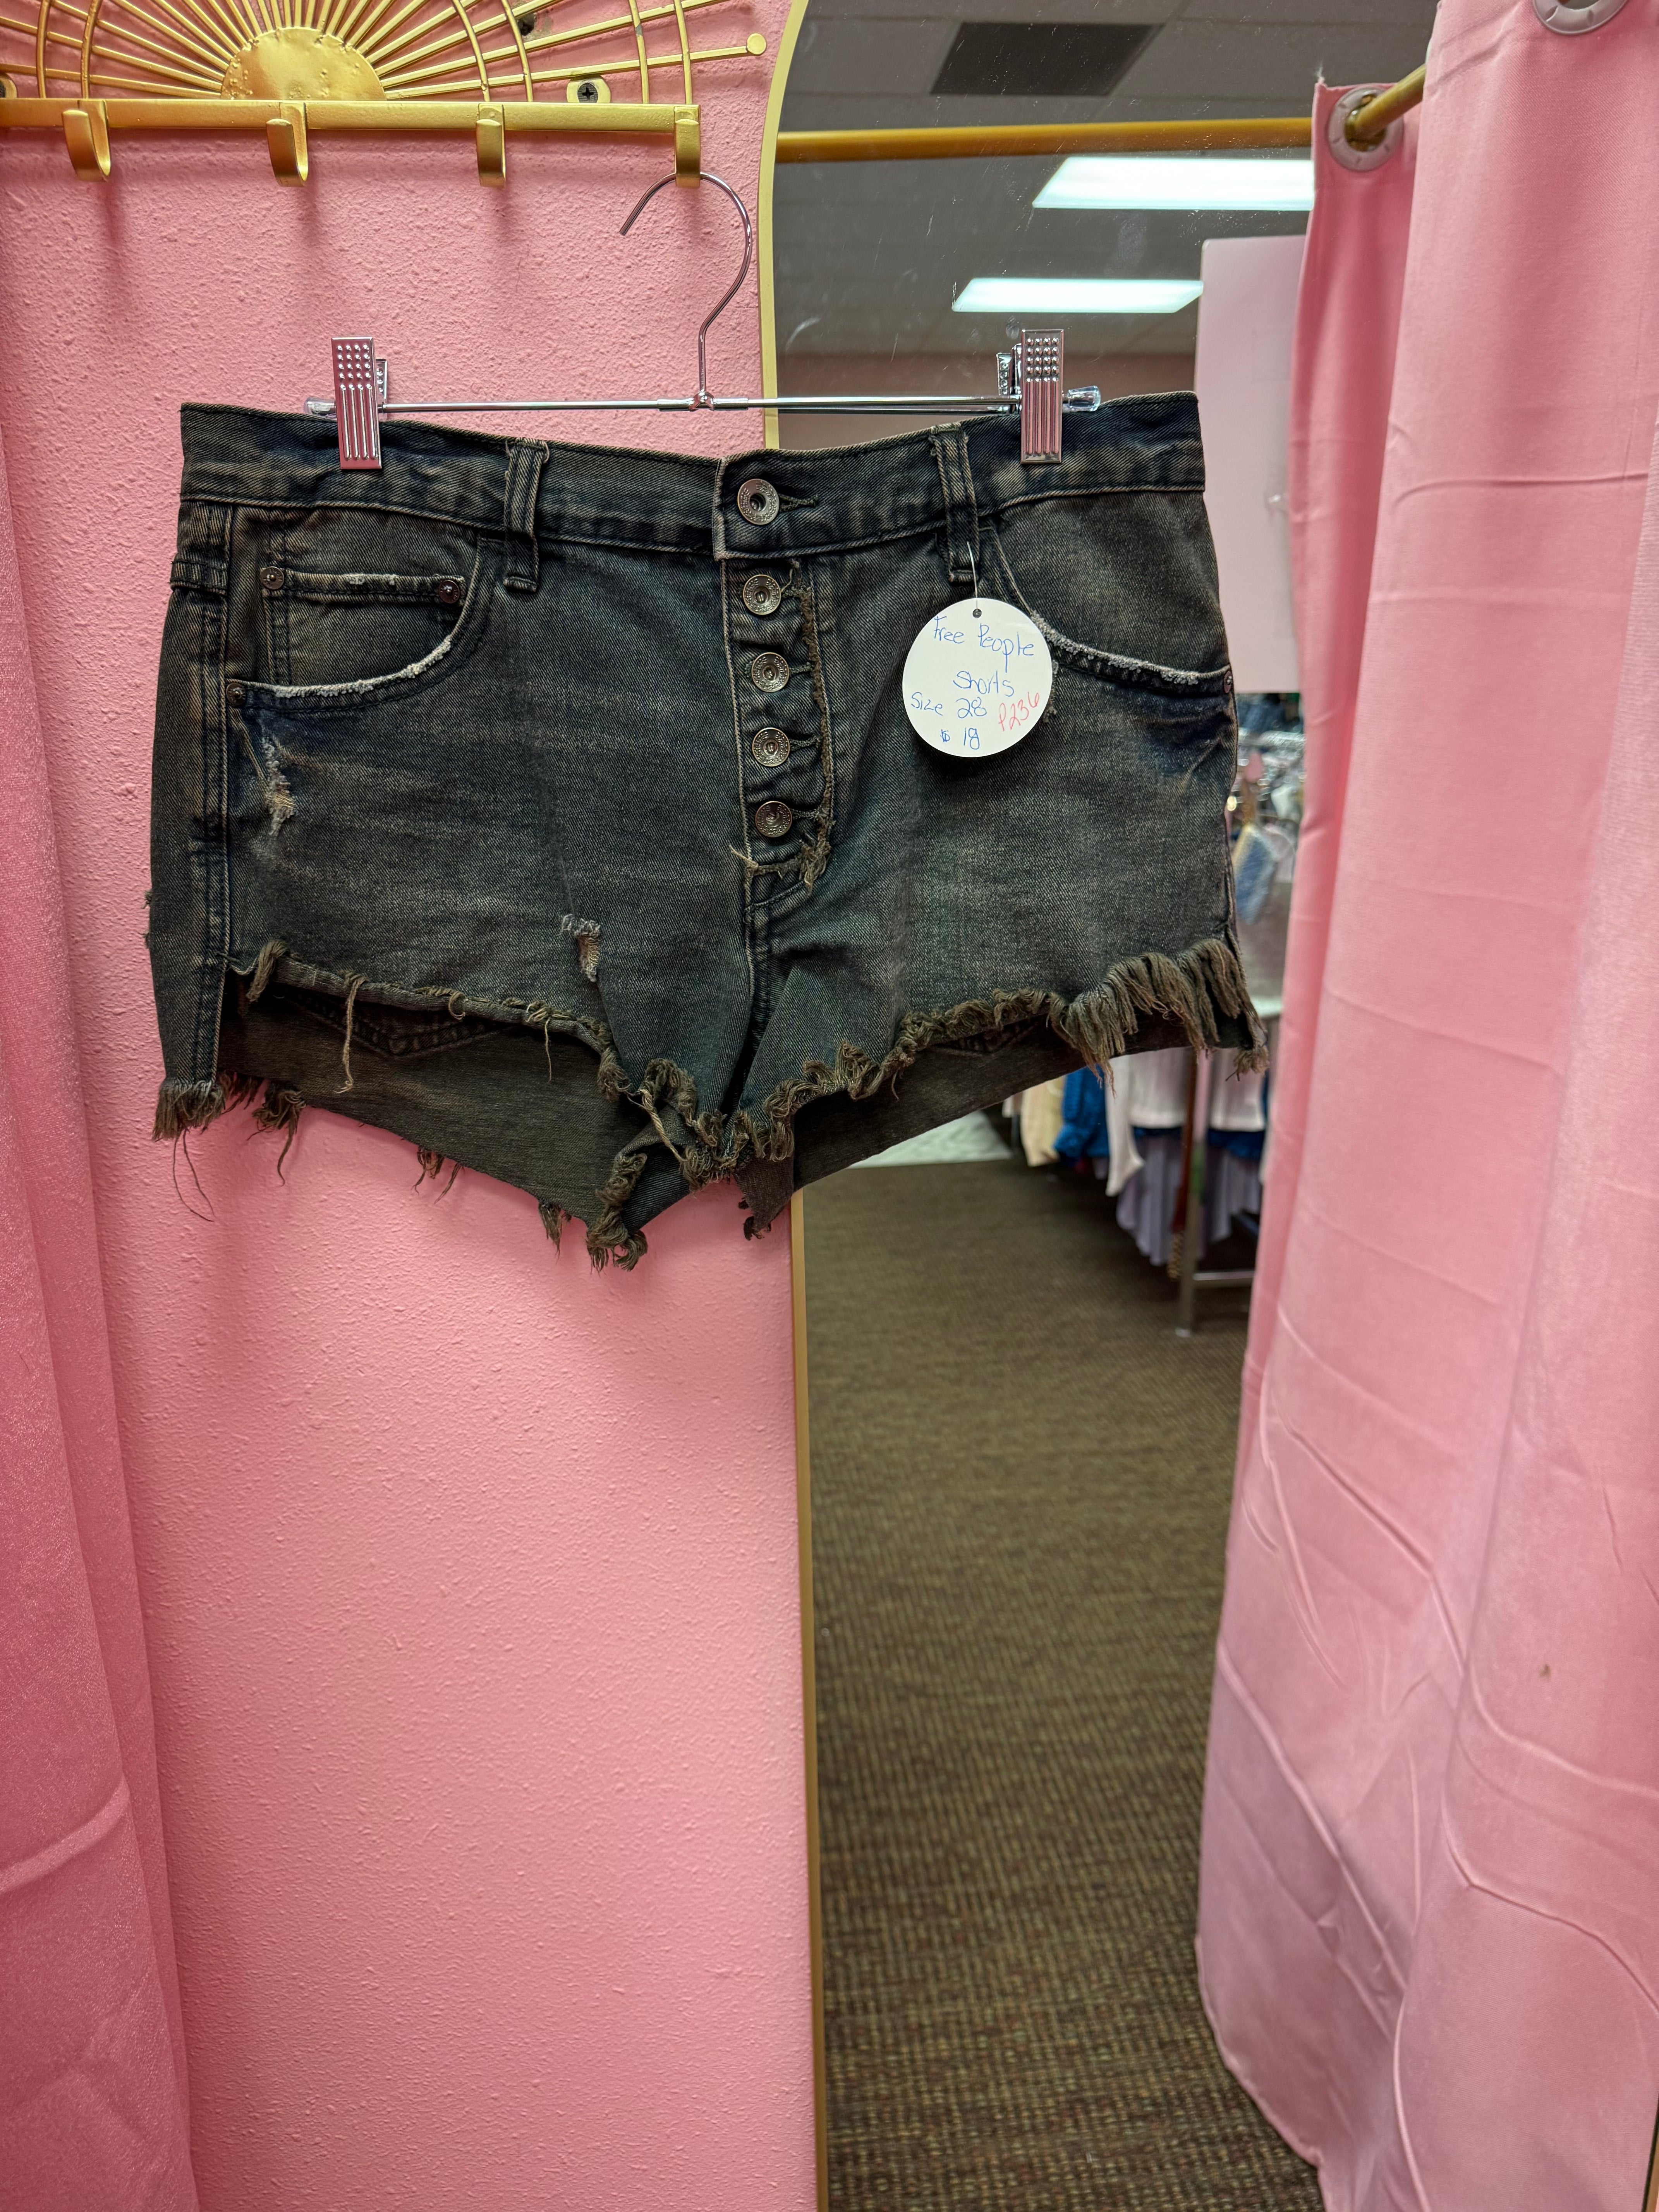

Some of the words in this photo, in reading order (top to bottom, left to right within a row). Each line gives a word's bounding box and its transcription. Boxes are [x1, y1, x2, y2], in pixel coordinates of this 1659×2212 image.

[934, 616, 965, 644] Free
[977, 623, 1034, 673] People
[953, 670, 1014, 697] Shorts
[911, 692, 943, 716] Size
[955, 697, 987, 719] 28
[963, 727, 980, 750] 18
